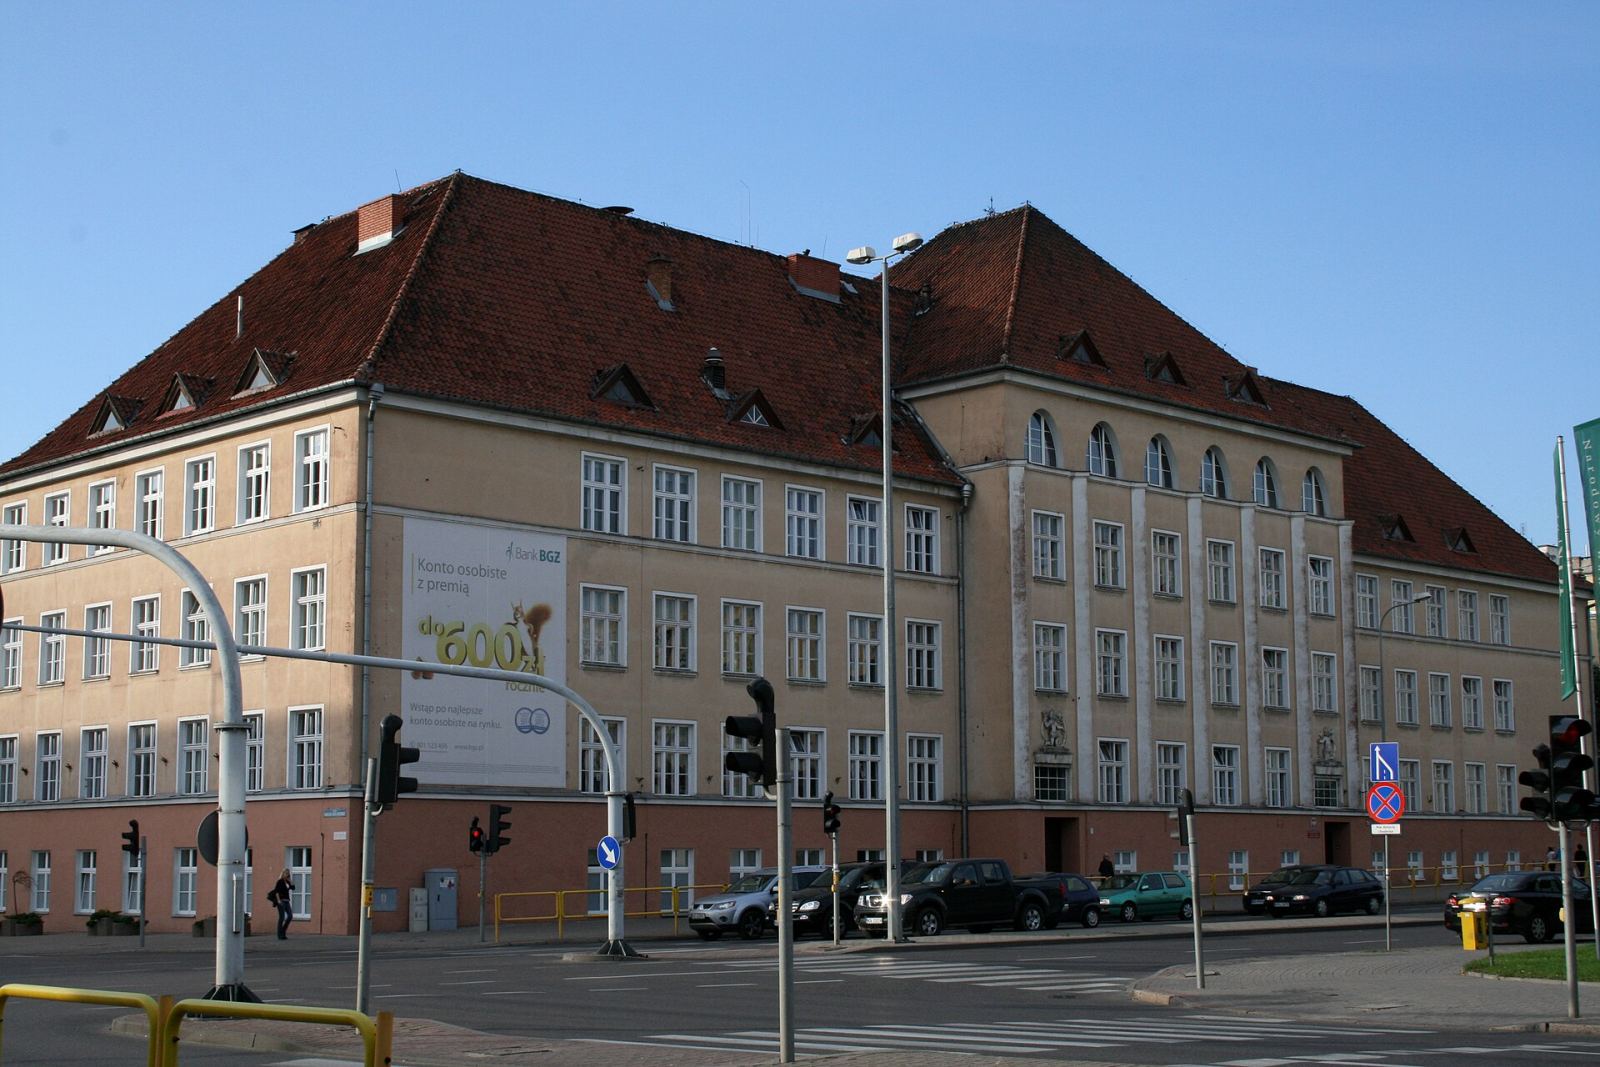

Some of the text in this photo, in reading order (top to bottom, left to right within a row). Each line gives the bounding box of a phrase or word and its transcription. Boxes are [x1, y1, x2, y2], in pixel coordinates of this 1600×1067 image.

[515, 547, 538, 561] Bank
[418, 558, 508, 580] Konto osobiste
[417, 579, 470, 597] z premią
[418, 615, 445, 637] do
[436, 621, 523, 671] 600
[504, 679, 545, 693] rocznie
[409, 702, 483, 716] Wstąp po najlepsze
[410, 715, 433, 726] konto
[434, 717, 467, 728] osobiste
[467, 720, 477, 728] na
